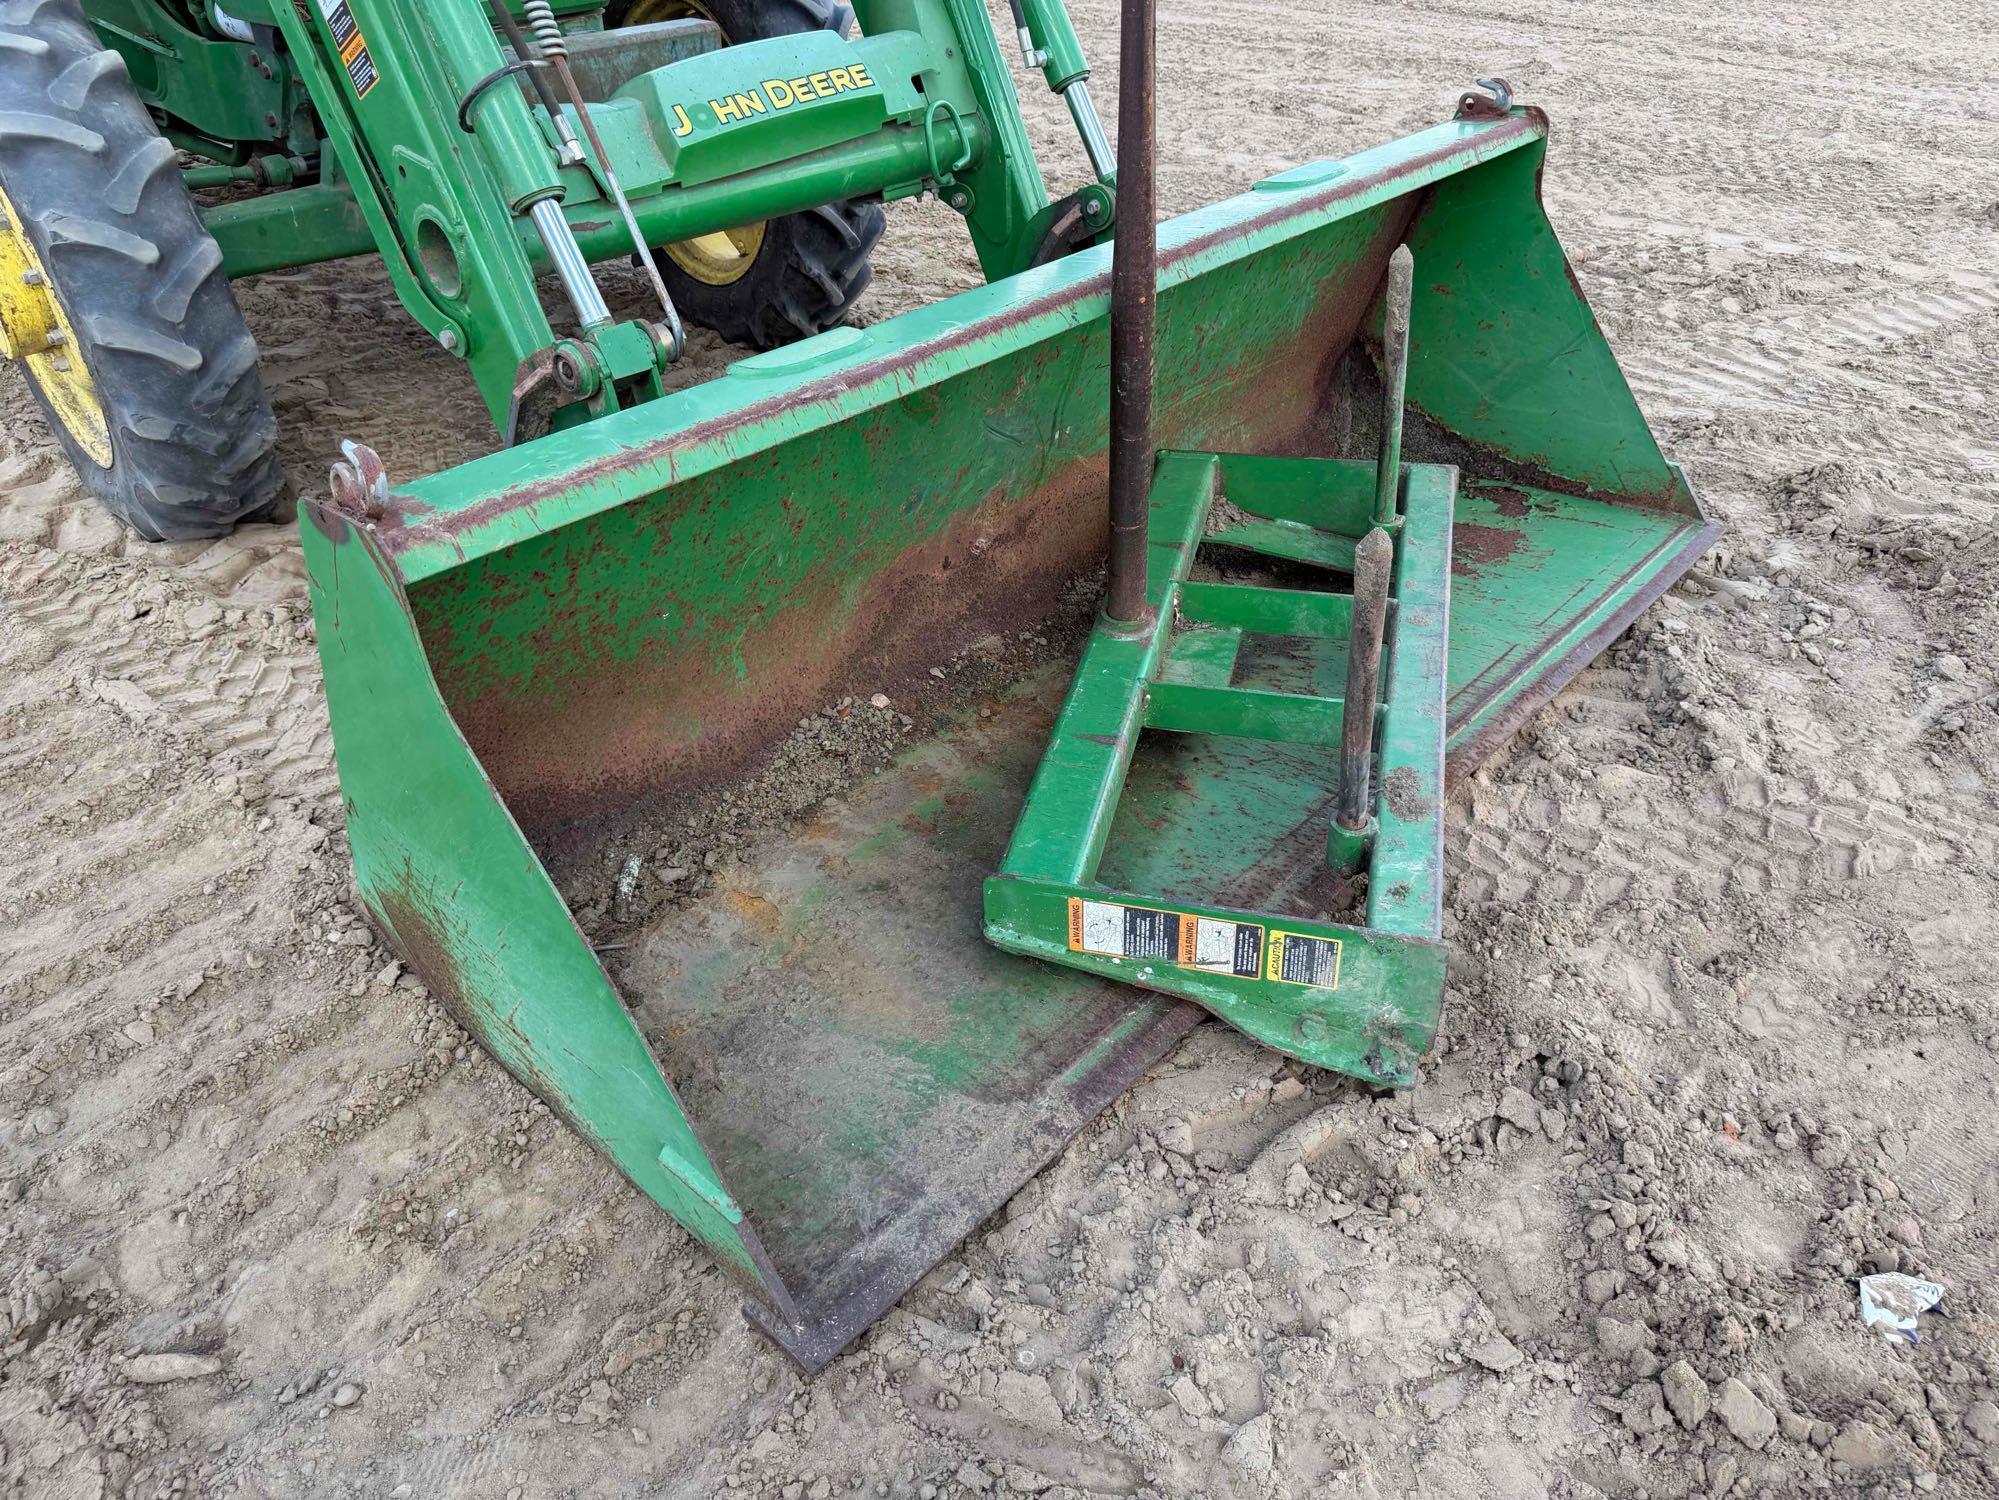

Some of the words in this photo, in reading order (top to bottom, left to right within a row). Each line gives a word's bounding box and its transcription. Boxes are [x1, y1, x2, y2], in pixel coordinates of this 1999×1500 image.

[671, 88, 768, 138] JHN
[761, 63, 875, 111] DEERE
[1072, 904, 1080, 937] WARNING
[1185, 921, 1194, 955] WARNING
